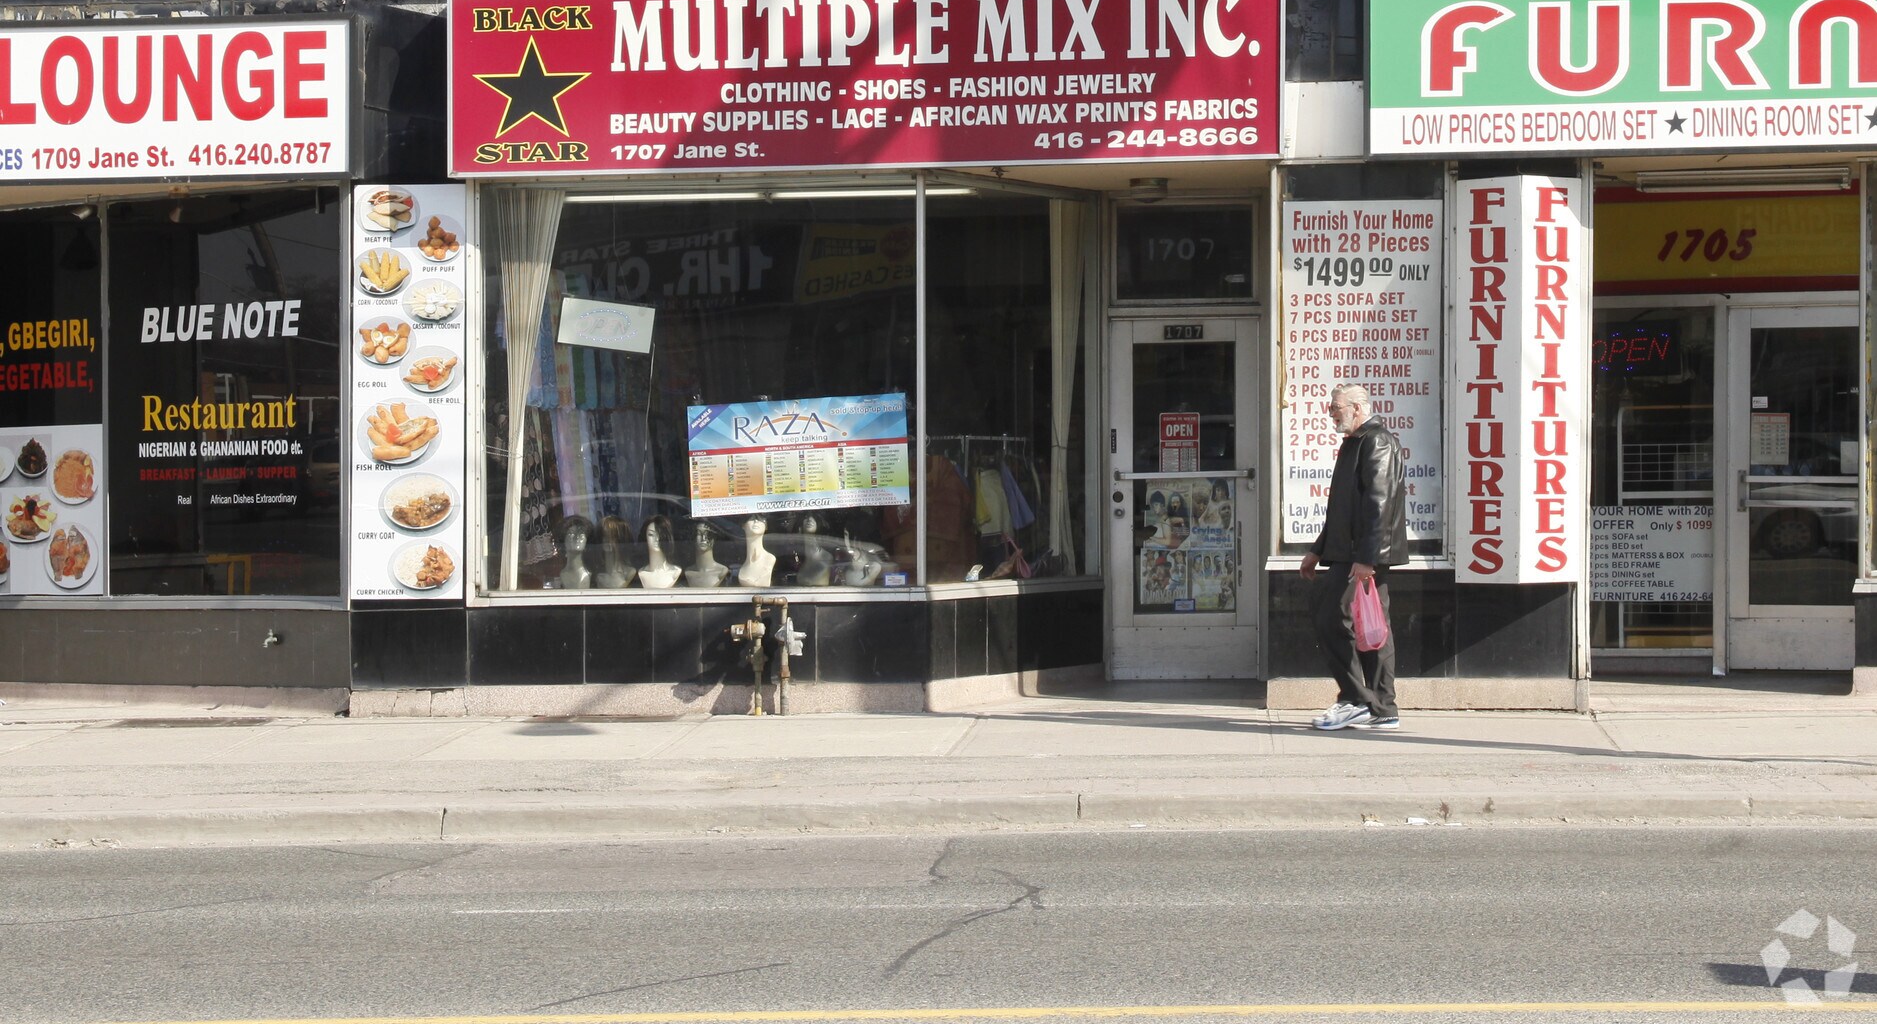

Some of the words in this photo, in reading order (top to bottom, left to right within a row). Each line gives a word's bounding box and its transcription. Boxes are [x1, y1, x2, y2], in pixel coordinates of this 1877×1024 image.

[473, 5, 592, 32] BLACK
[0, 31, 328, 125] LOUNGE
[721, 81, 832, 104] CLOTHING
[853, 79, 926, 101] SHOES
[949, 75, 1047, 99] FASHION
[1054, 73, 1156, 96] JEWELRY
[611, 112, 697, 134] BEAUTY
[703, 109, 808, 132] SUPPLIES
[832, 107, 887, 129] LACE
[909, 104, 1007, 128] AFRICAN
[1015, 104, 1068, 126] WAX
[1076, 101, 1157, 123] PRINTS
[1165, 98, 1258, 121] FABRICS
[1402, 114, 1444, 145] LOW
[1448, 112, 1515, 144] PRICES
[1522, 111, 1617, 142] BEDROOM
[1623, 109, 1658, 140] SET
[1693, 107, 1757, 137] DINING
[1764, 106, 1822, 136] ROOM
[1828, 105, 1863, 135] SET
[1034, 133, 1083, 149] 416
[1107, 127, 1258, 148] 244-8666
[31, 148, 81, 170] 1709
[88, 147, 139, 168] Jane
[146, 146, 175, 167] St.
[188, 142, 331, 165] 416.240.8787
[474, 141, 589, 164] STAR
[611, 144, 666, 161] 1707
[673, 144, 727, 159] Jane
[735, 142, 765, 158] St.
[1293, 210, 1348, 231] Furnish
[1354, 210, 1387, 230] Your
[1393, 209, 1433, 229] Home
[1149, 238, 1215, 261] 1707
[1292, 233, 1331, 253] with
[1338, 233, 1361, 253] 28
[1368, 233, 1430, 252] Pieces
[1657, 229, 1757, 262] 1705
[1400, 264, 1430, 281] ONLY
[1290, 294, 1298, 307] 3
[1304, 294, 1332, 306] PCS
[1338, 293, 1374, 306] SOFA
[1379, 292, 1405, 305] SET
[141, 304, 215, 343] BLUE
[222, 300, 301, 339] NOTE
[1290, 312, 1298, 324] 7
[1304, 311, 1331, 324] PCS
[1338, 310, 1386, 323] DINING
[1392, 310, 1417, 322] SET
[8, 318, 95, 351] GBEGIRI,
[1290, 330, 1297, 343] 6
[1302, 330, 1327, 342] PCS
[1332, 329, 1357, 342] BED
[1362, 328, 1400, 342] ROOM
[1406, 328, 1429, 341] SET
[1290, 348, 1295, 361] 2
[1300, 348, 1320, 360] PCS
[1324, 347, 1378, 360] MATTRESS
[1381, 347, 1388, 359] &
[1392, 346, 1413, 359] BOX
[1593, 337, 1670, 363] OPEN
[1302, 366, 1320, 378] PC
[1334, 365, 1359, 378] BED
[1365, 365, 1411, 377] FRAME
[1466, 187, 1509, 575] FURNITURES
[1531, 186, 1570, 572] FURNITURES
[1302, 384, 1327, 397] PCS
[1390, 383, 1429, 395] TABLE
[142, 393, 297, 431] Restaurant
[733, 412, 826, 443] RAZA
[1166, 424, 1193, 437] OPEN
[1302, 418, 1327, 430] PCS
[139, 442, 186, 457] NIGERIAN
[189, 442, 197, 456] &
[200, 441, 258, 457] GHANANIAN
[261, 440, 288, 455] FOOD
[290, 442, 303, 455] etc.
[1306, 434, 1337, 445] PCS
[1302, 450, 1319, 461] PC
[140, 468, 196, 480] BREAKFAST
[206, 468, 246, 479] LAUNCH
[257, 467, 297, 478] SUPPER
[178, 496, 192, 505] Real
[210, 494, 231, 504] African
[233, 494, 255, 504] Dishes
[256, 494, 297, 505] Extraordinary
[757, 498, 831, 510] www.raza.com
[1289, 505, 1308, 518] Lay
[1409, 501, 1436, 514] Year
[1591, 507, 1624, 516] YOUR
[1628, 506, 1663, 515] HOME
[1668, 506, 1691, 516] with
[1593, 520, 1634, 529] OFFER
[1650, 522, 1673, 532] Only
[1593, 592, 1654, 600] FURNITURE
